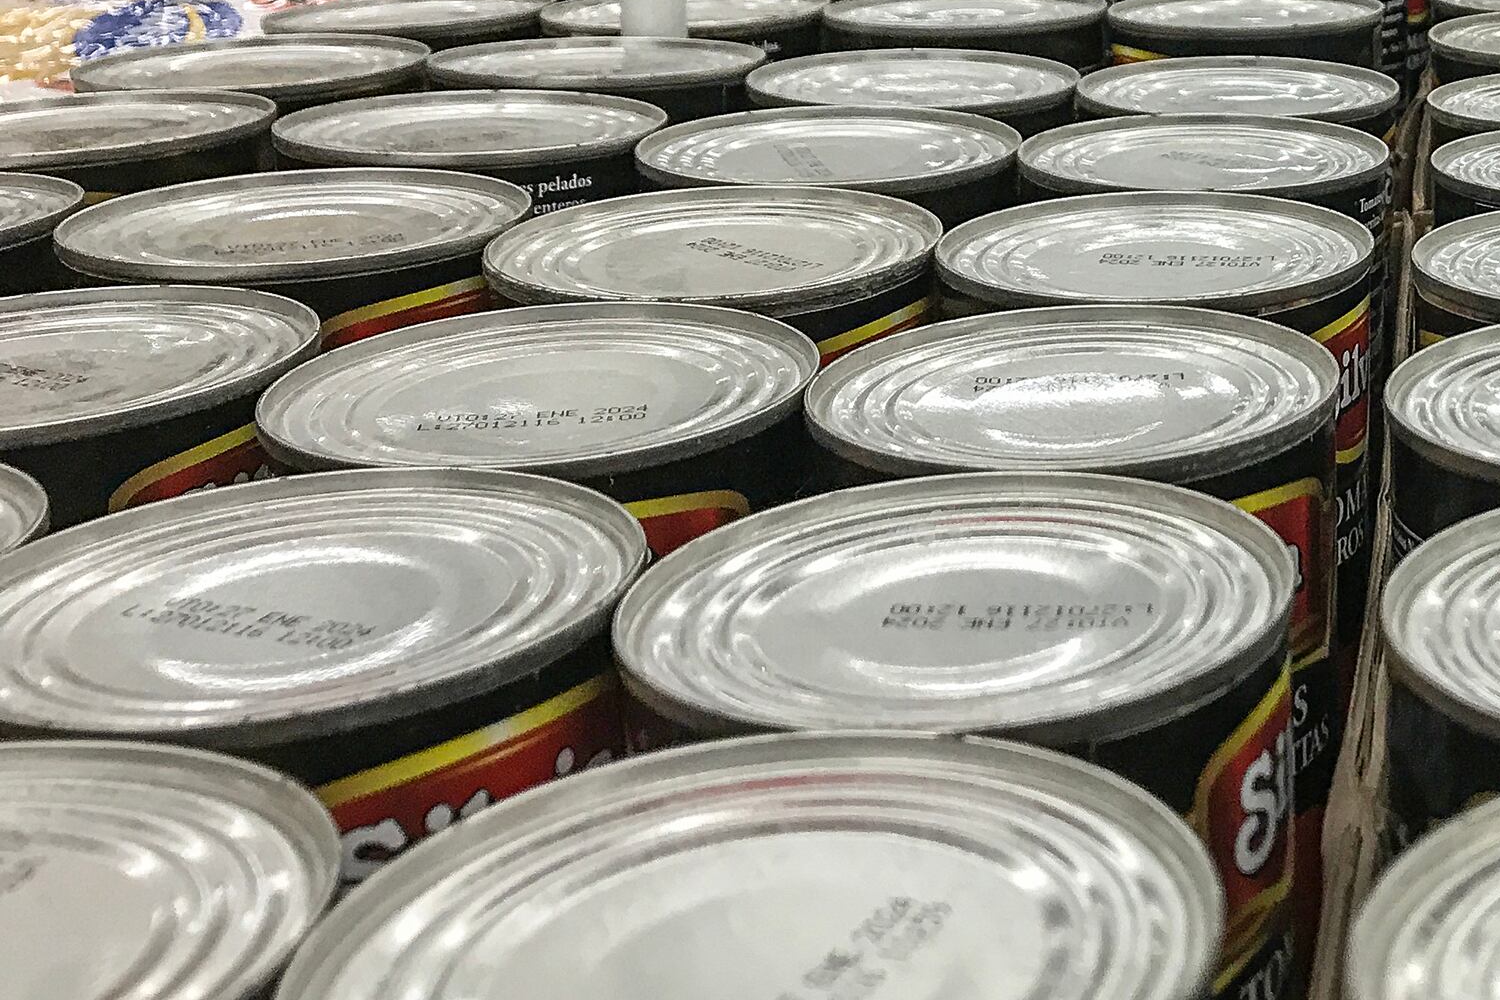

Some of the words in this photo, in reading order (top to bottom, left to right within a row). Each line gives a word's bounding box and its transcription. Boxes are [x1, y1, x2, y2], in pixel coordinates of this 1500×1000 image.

[538, 173, 592, 198] pelados
[536, 408, 579, 419] ENE
[593, 403, 649, 416] 2024
[578, 412, 647, 425] 12:00
